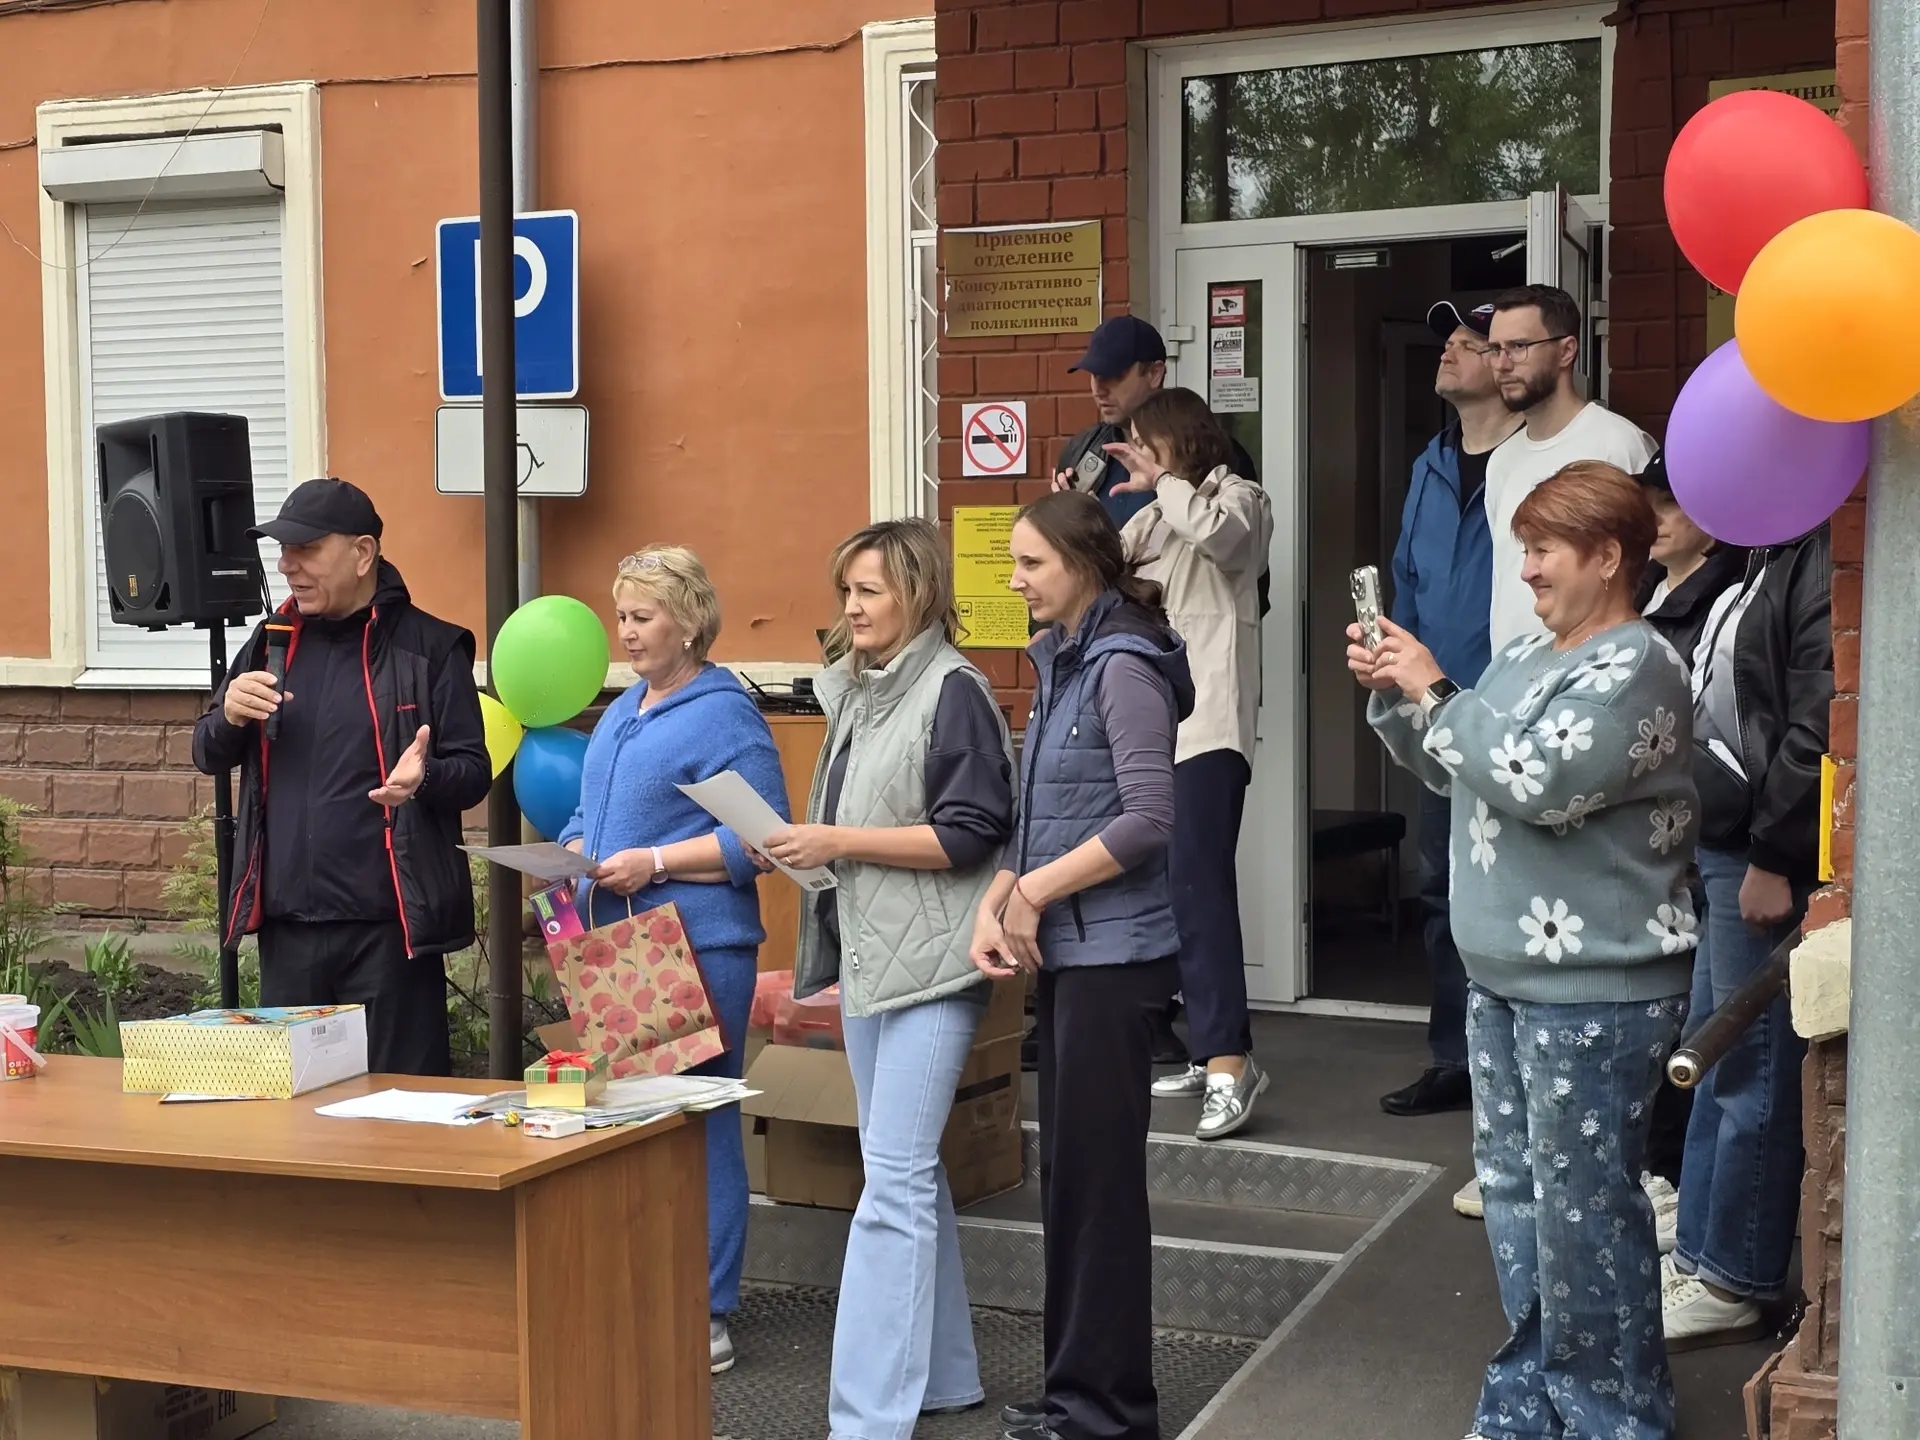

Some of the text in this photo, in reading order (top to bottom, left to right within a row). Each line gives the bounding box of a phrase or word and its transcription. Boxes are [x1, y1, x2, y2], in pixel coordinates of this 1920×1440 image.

[974, 231, 1074, 250] Приемное
[974, 251, 1074, 268] отделение
[954, 276, 1083, 294] Консультативно
[474, 236, 547, 376] P
[956, 296, 1092, 314] диагностическая
[970, 316, 1078, 331] поликлиника
